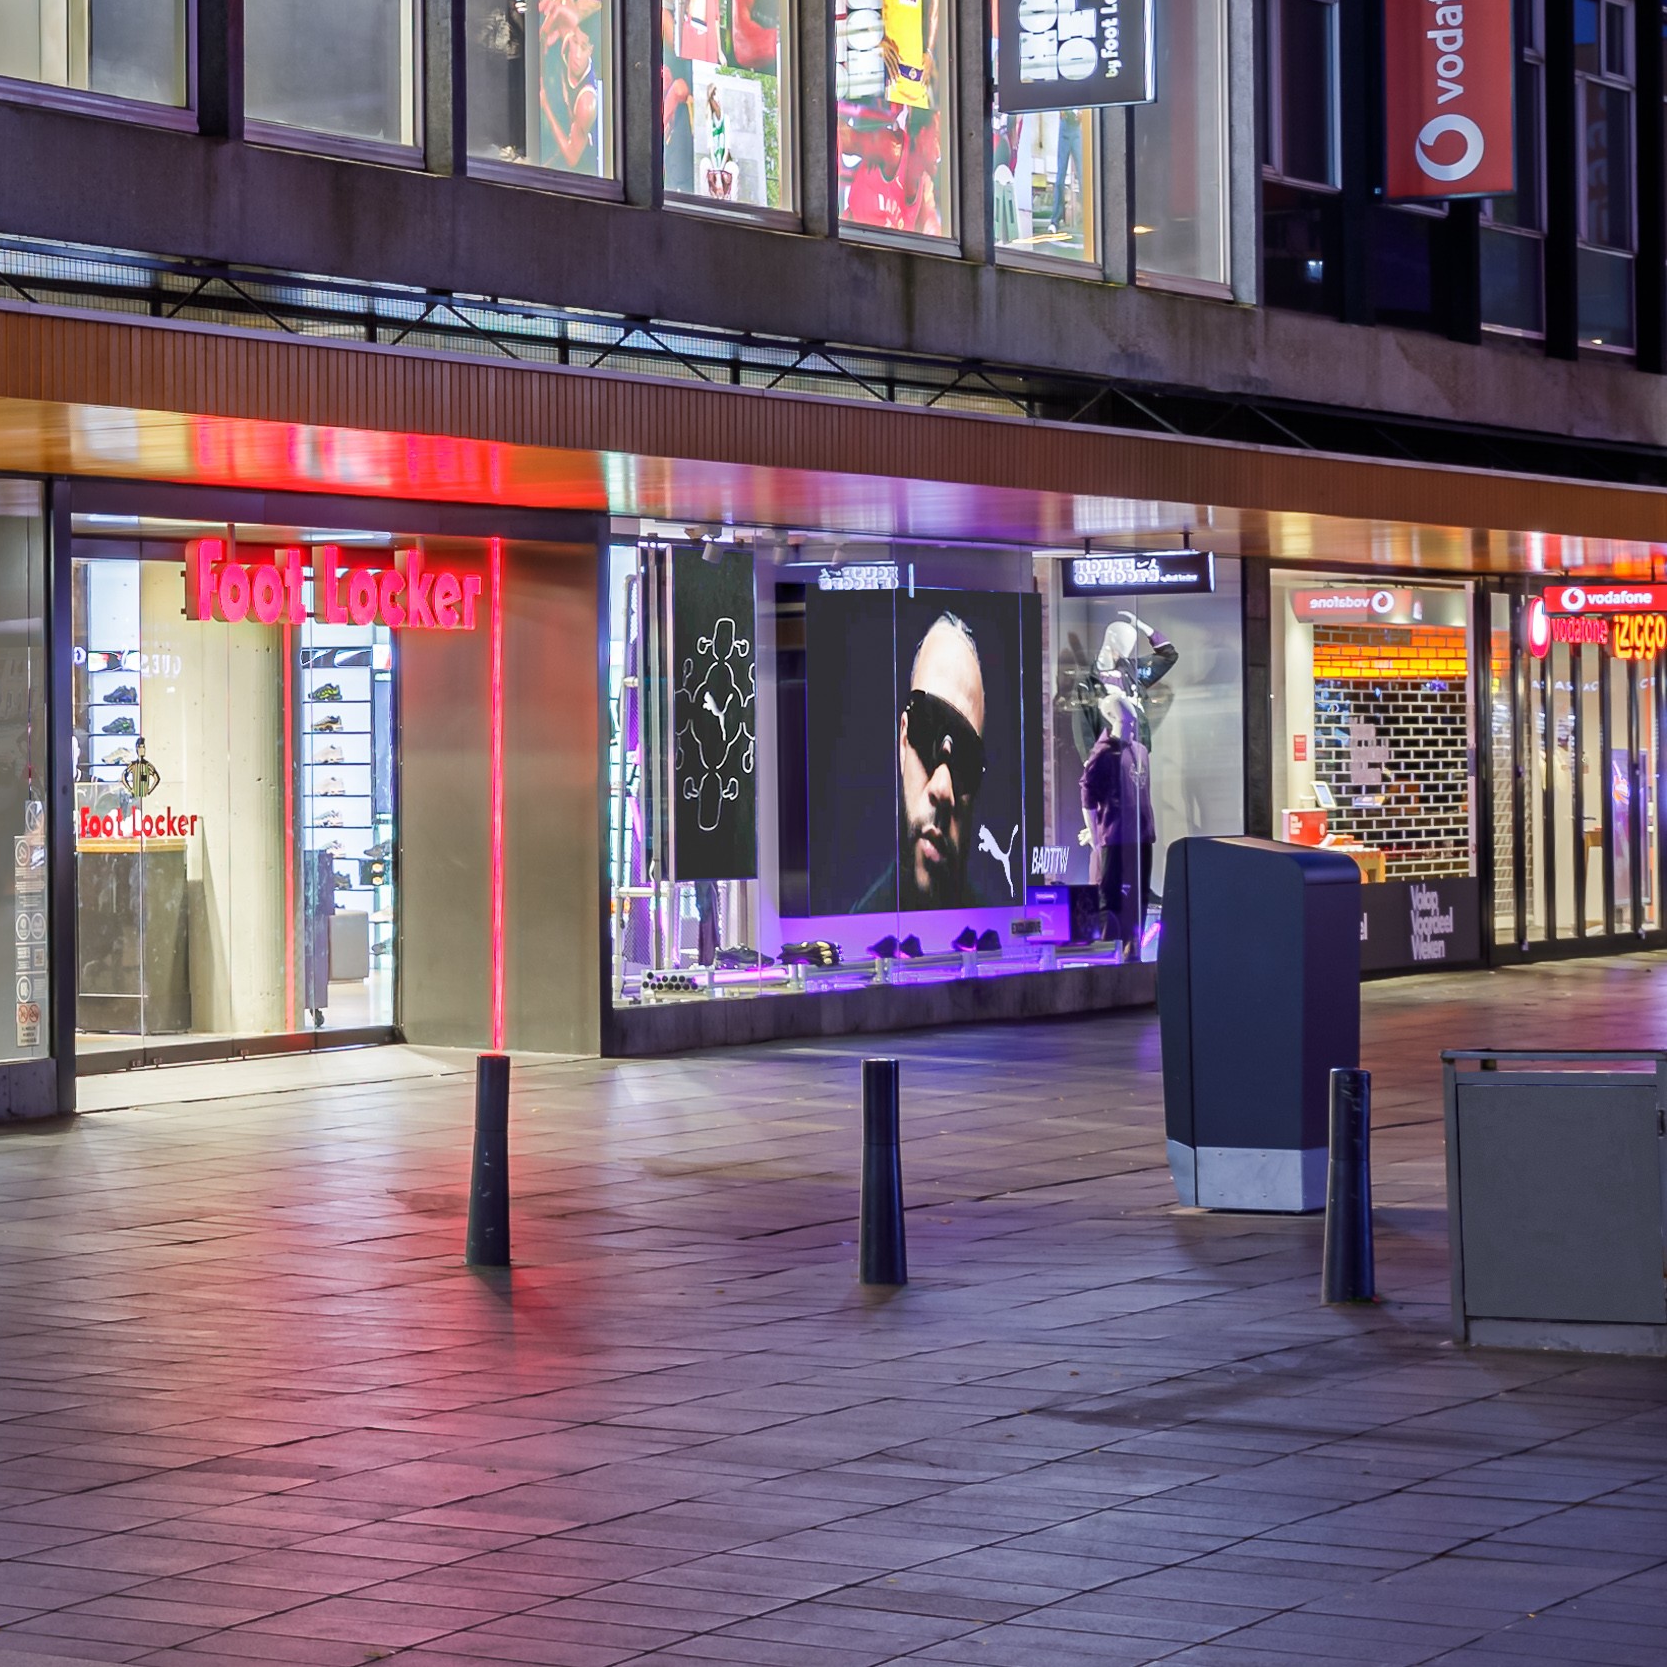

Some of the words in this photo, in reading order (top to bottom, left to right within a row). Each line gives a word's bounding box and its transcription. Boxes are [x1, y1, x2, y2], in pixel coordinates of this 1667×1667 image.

[1100, 16, 1118, 60] Foot
[186, 538, 306, 624] Foot
[313, 544, 483, 631] Locker
[1586, 590, 1654, 605] vodafone
[1550, 615, 1608, 645] vodafone
[79, 806, 124, 838] Foot
[131, 806, 198, 838] Locker
[1031, 845, 1070, 875] BADTTW
